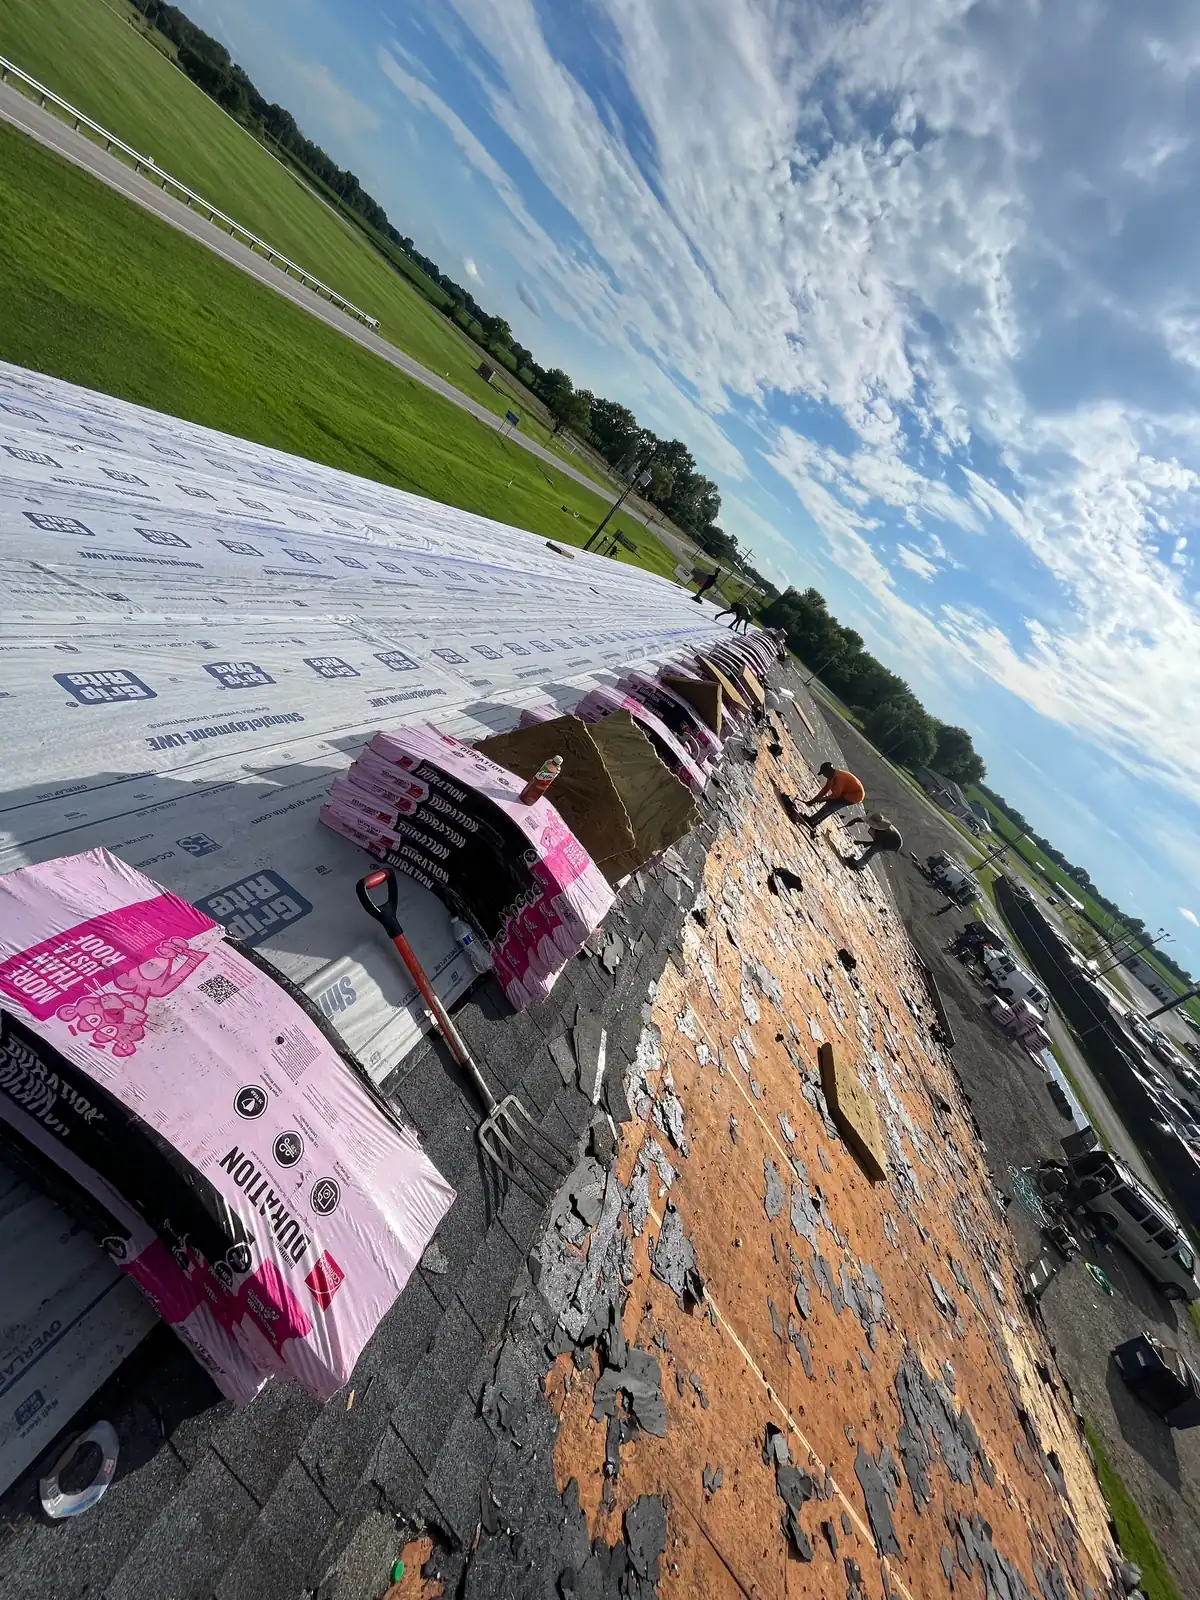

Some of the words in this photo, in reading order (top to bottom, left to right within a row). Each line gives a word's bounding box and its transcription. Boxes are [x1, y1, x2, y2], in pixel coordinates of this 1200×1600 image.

[67, 672, 127, 686] Rite
[223, 673, 268, 686] Grip
[320, 668, 352, 677] Grip
[79, 684, 147, 700] Grip
[145, 712, 305, 751] ShingleLayment-LWE
[460, 747, 505, 774] DURATION
[53, 784, 87, 798] OVERLAP
[416, 766, 469, 804] DURATION
[415, 809, 467, 850] DURATION
[428, 795, 480, 834] DURATION
[386, 853, 434, 890] DURATION
[207, 874, 280, 917] Rite
[226, 894, 303, 940] Grip
[53, 942, 74, 956] A
[63, 948, 105, 977] JUST
[71, 933, 127, 967] ROOF
[4, 963, 62, 1005] MORE
[27, 950, 84, 991] THAN
[3, 1035, 104, 1125] DURATION
[217, 1145, 312, 1264] DURATION
